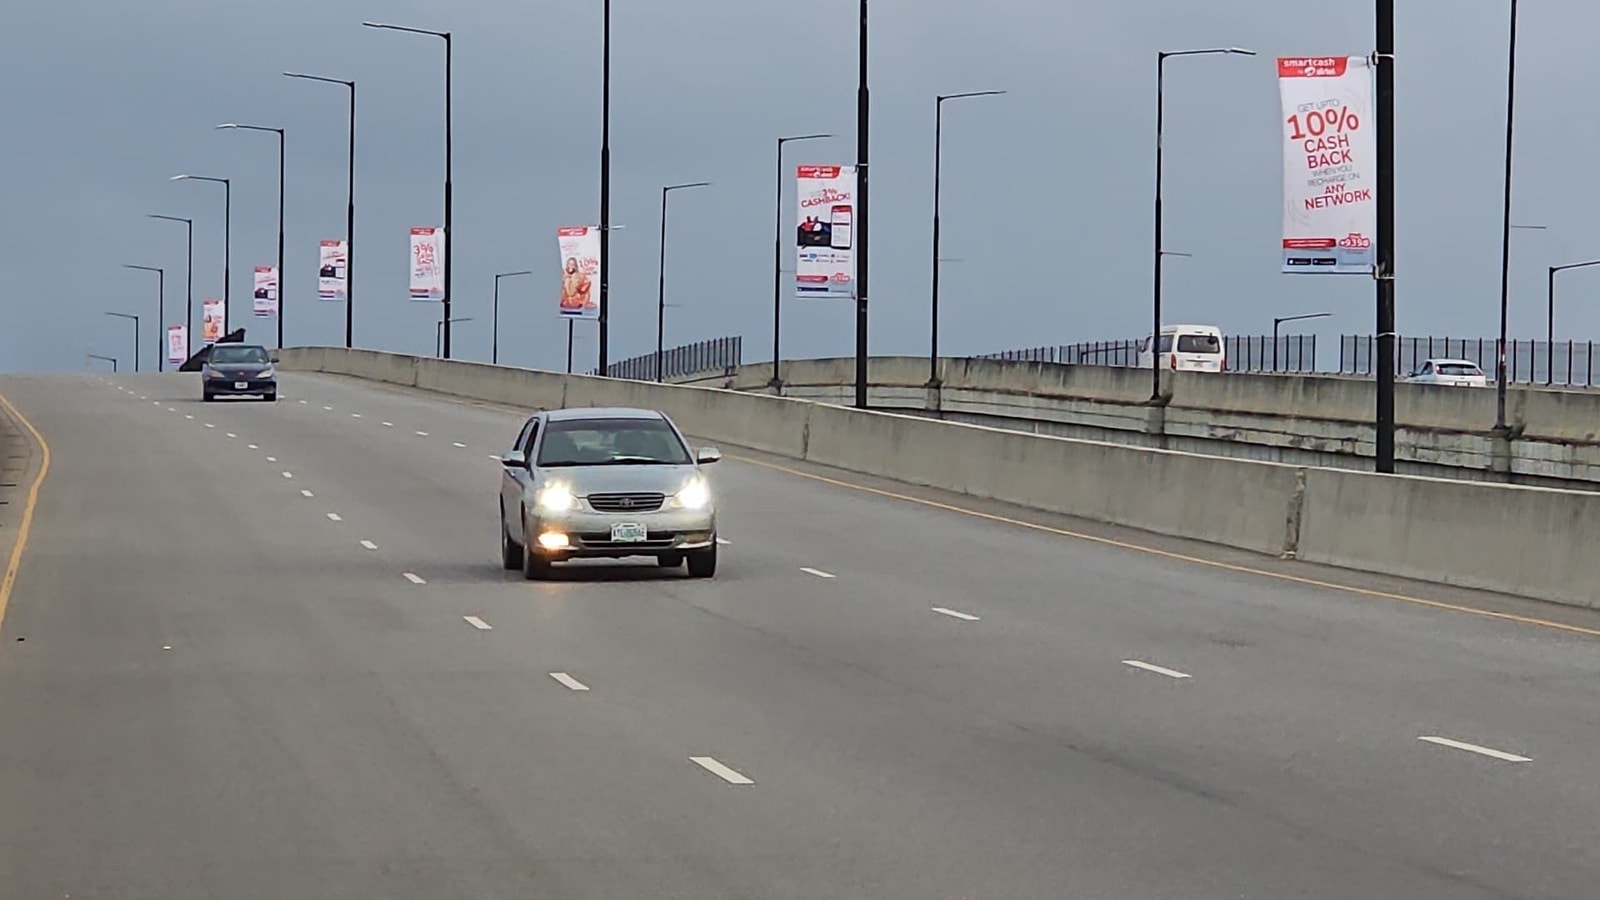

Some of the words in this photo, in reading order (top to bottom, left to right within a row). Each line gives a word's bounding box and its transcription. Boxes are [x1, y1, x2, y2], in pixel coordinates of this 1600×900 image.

[1283, 58, 1335, 67] smartcash
[1298, 102, 1314, 113] GET
[1287, 105, 1359, 140] 10%
[1304, 133, 1349, 153] CASH
[1307, 149, 1353, 169] BACK
[1336, 165, 1352, 173] YOU
[1348, 173, 1361, 181] ON
[1325, 183, 1346, 194] ANY
[1304, 189, 1371, 210] NETWORK
